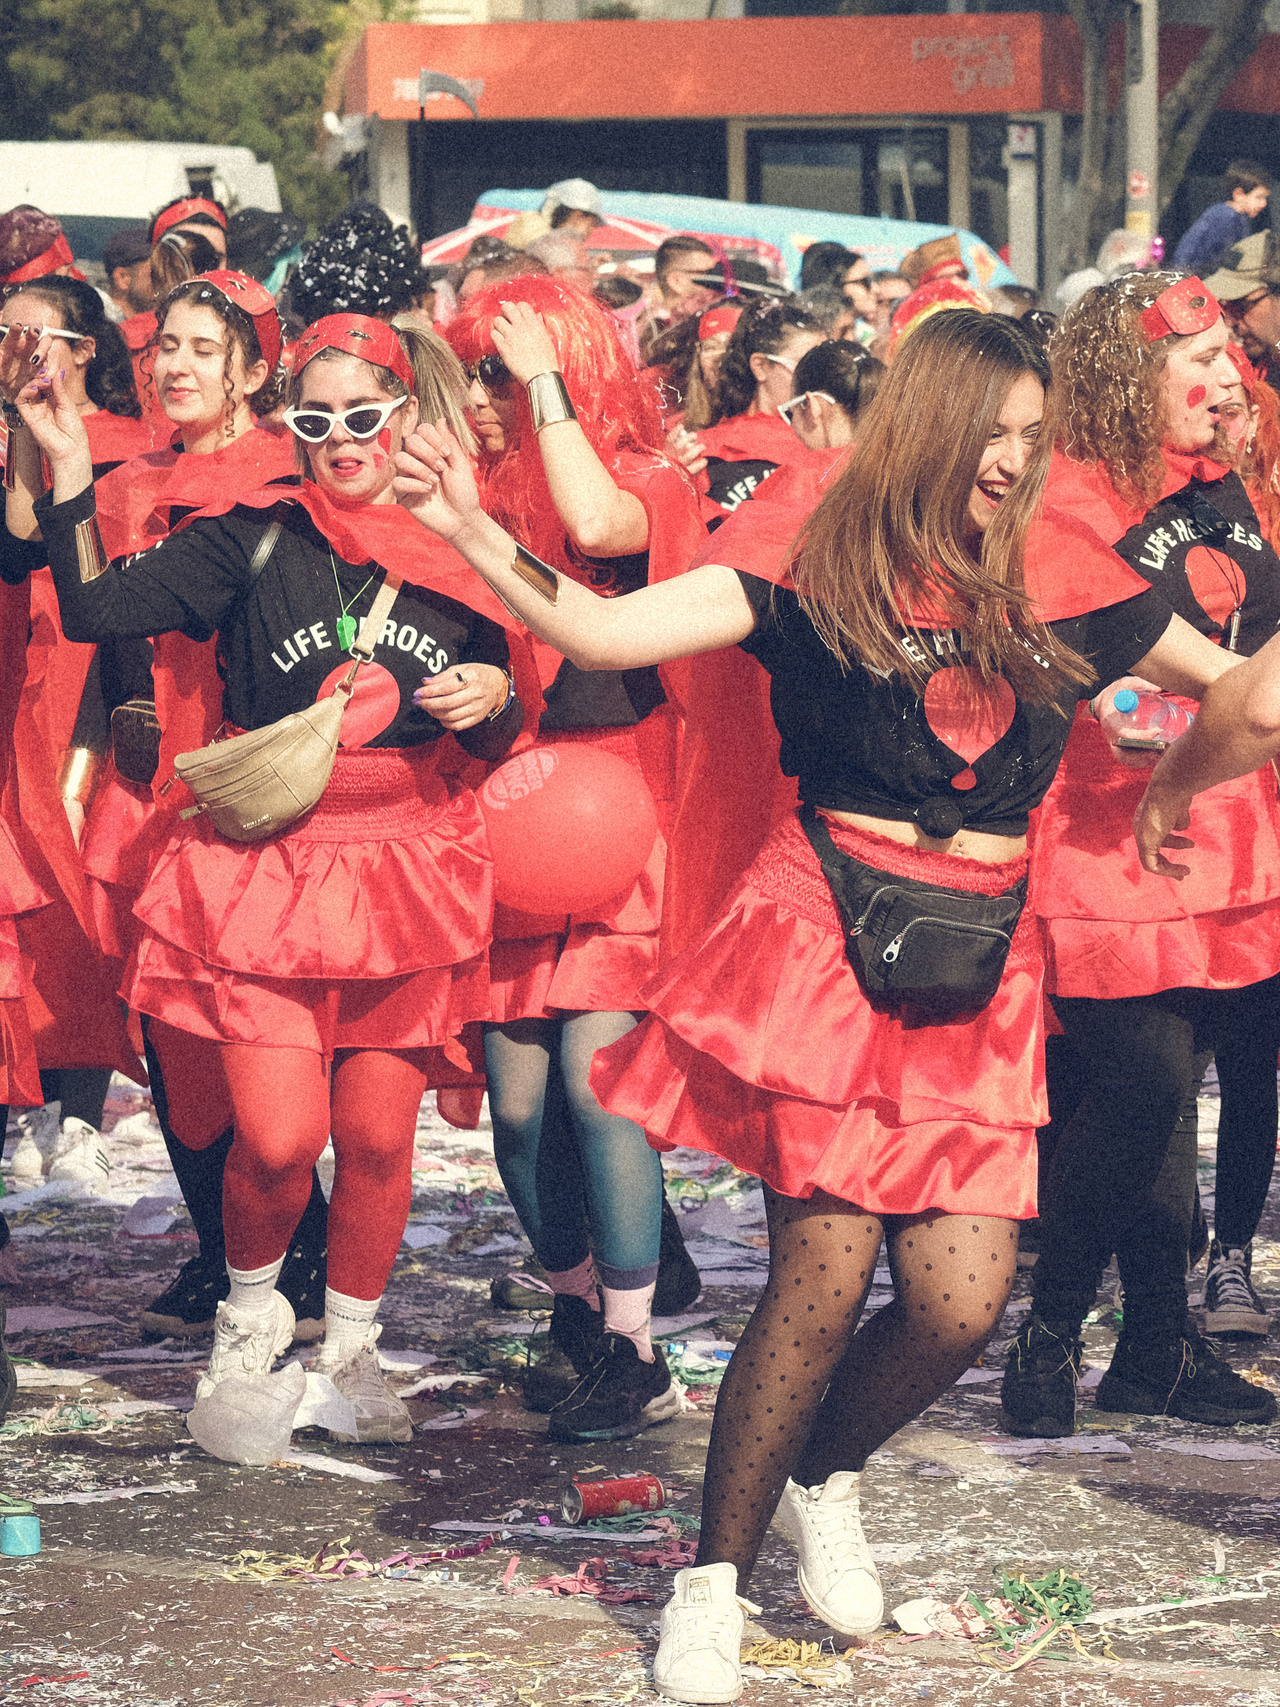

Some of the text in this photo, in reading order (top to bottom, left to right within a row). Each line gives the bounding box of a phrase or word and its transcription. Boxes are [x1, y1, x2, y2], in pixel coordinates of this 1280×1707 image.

[1139, 527, 1178, 570] LIFE
[271, 616, 448, 674] LIFE ROES
